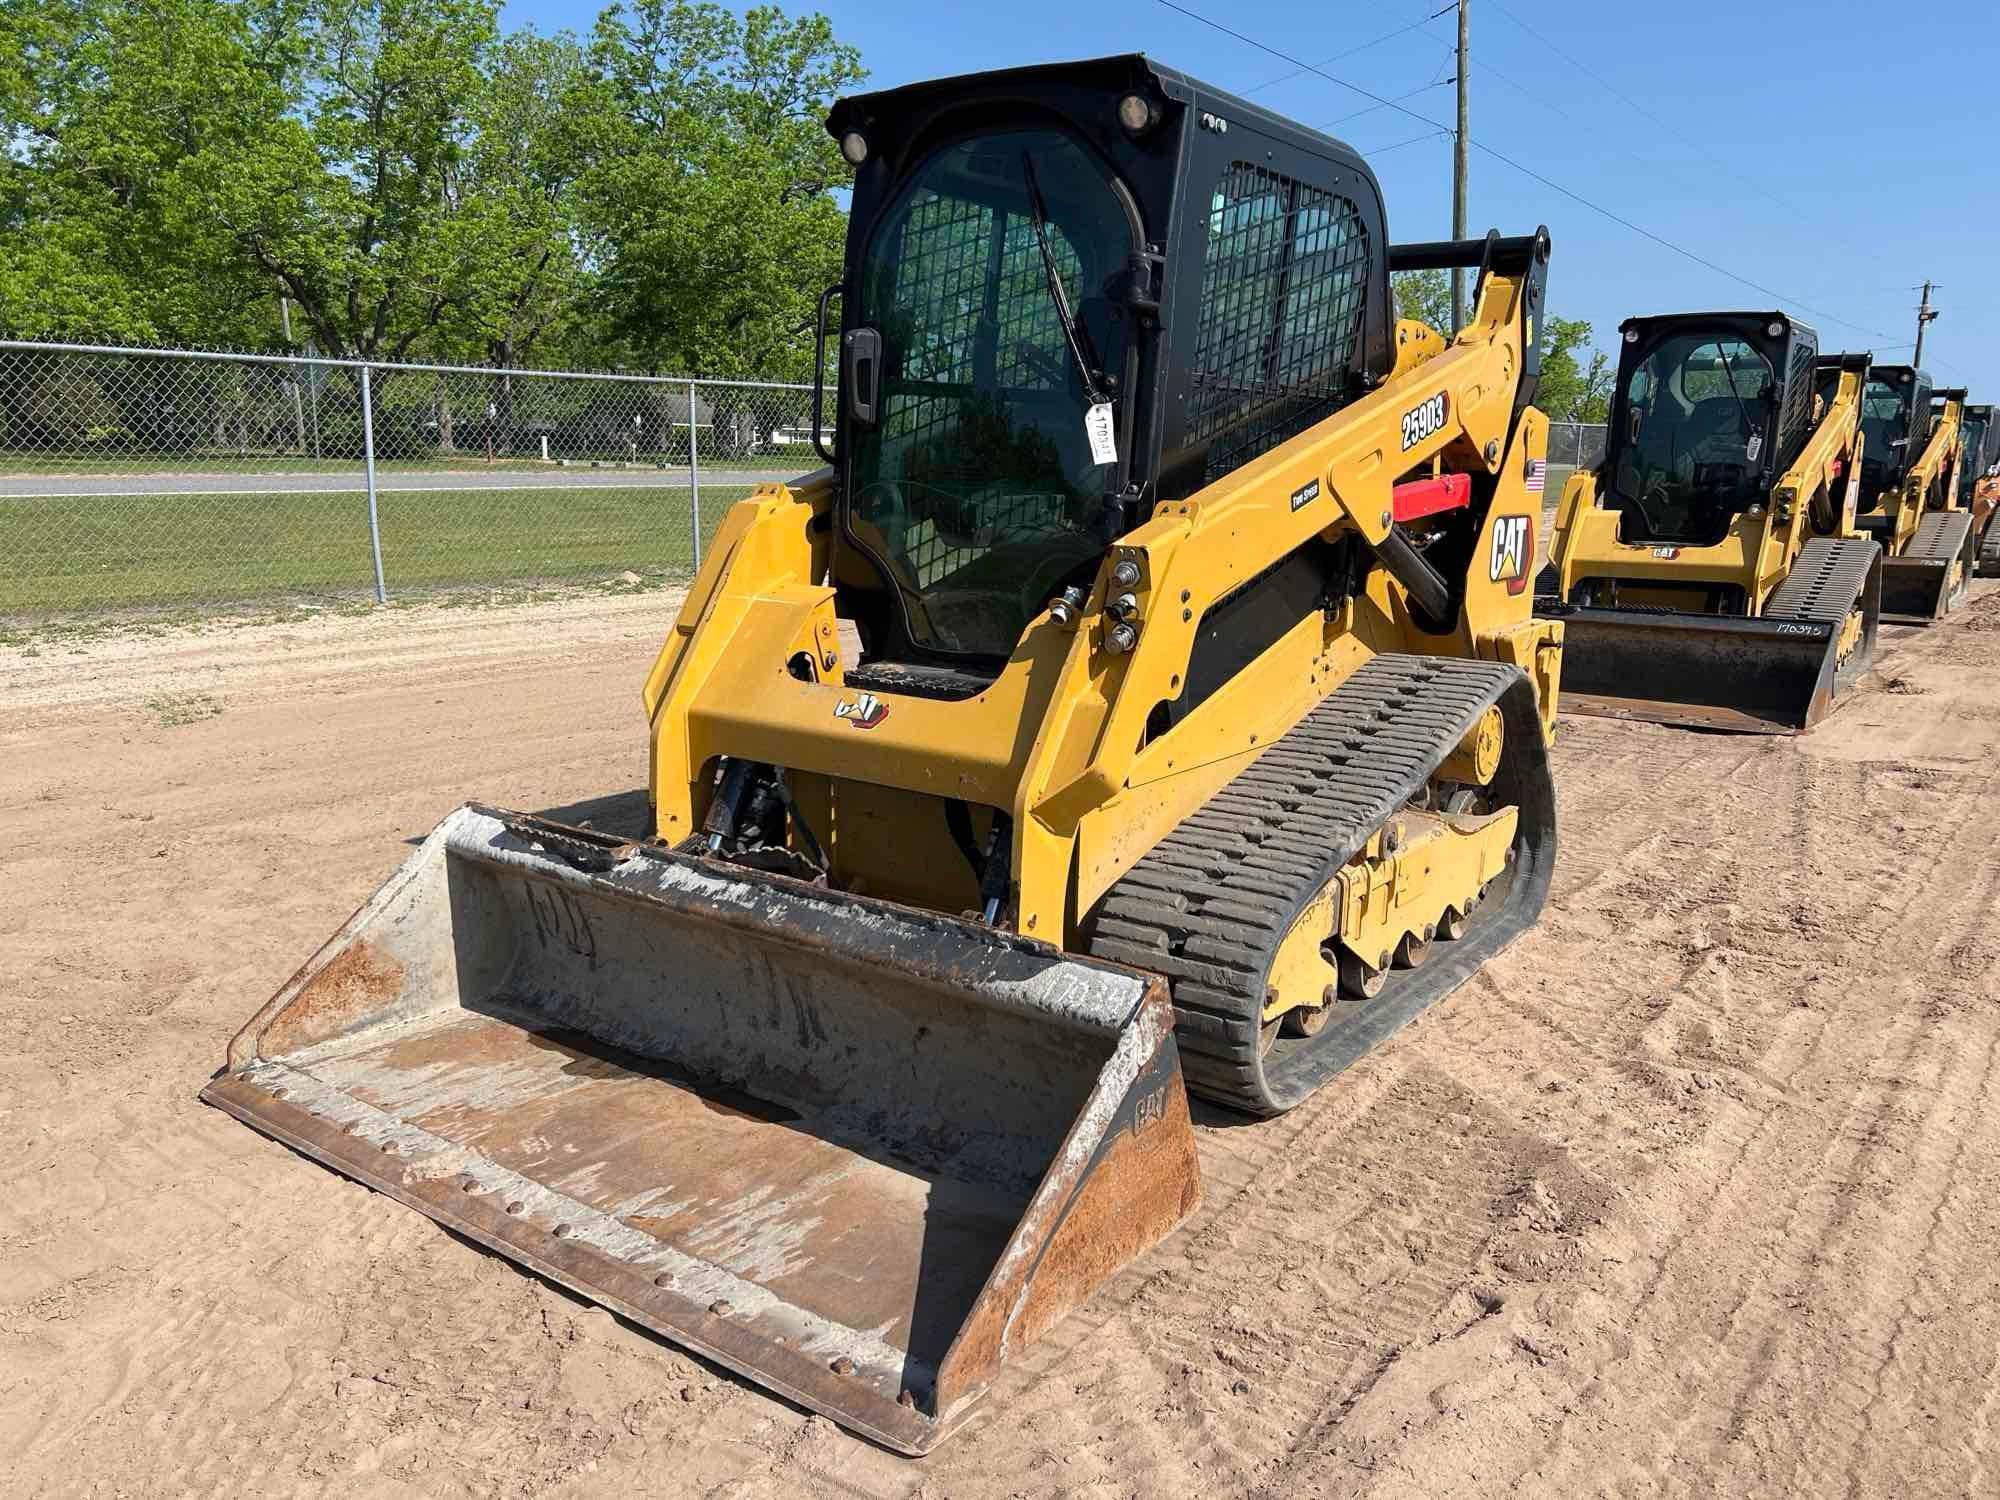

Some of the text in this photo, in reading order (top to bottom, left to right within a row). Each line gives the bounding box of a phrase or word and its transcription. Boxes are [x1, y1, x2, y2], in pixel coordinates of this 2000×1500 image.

[1402, 394, 1444, 449] 259D3
[1490, 517, 1528, 580] CAT
[1133, 1087, 1168, 1137] CAT
